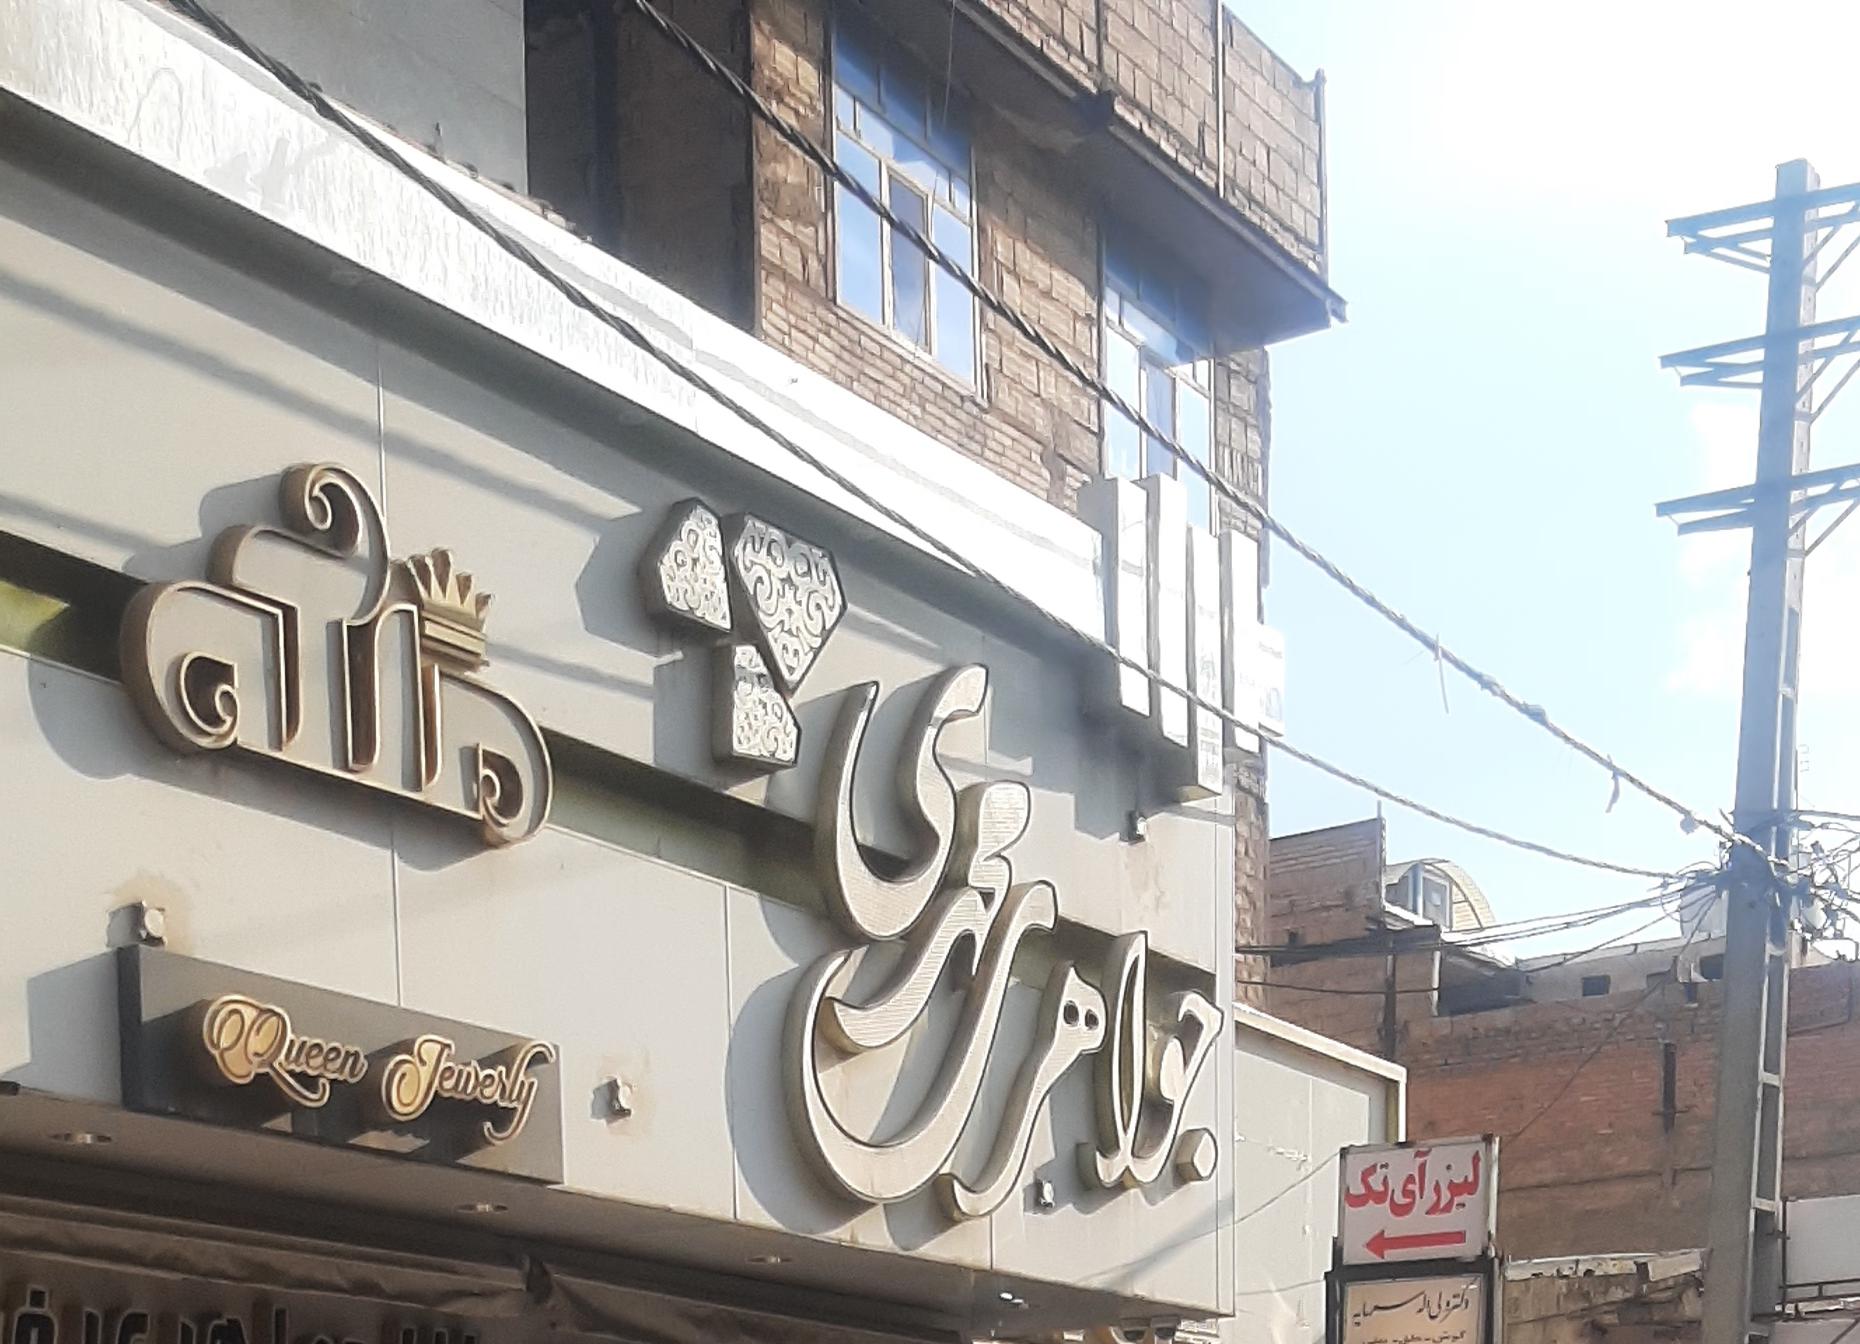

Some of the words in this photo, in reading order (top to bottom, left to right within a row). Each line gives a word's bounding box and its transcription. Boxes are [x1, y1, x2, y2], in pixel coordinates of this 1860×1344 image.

[202, 993, 368, 1107] Queen
[1344, 1160, 1389, 1209] تک
[1389, 1148, 1432, 1218] آی
[1425, 1150, 1482, 1216] لیزر
